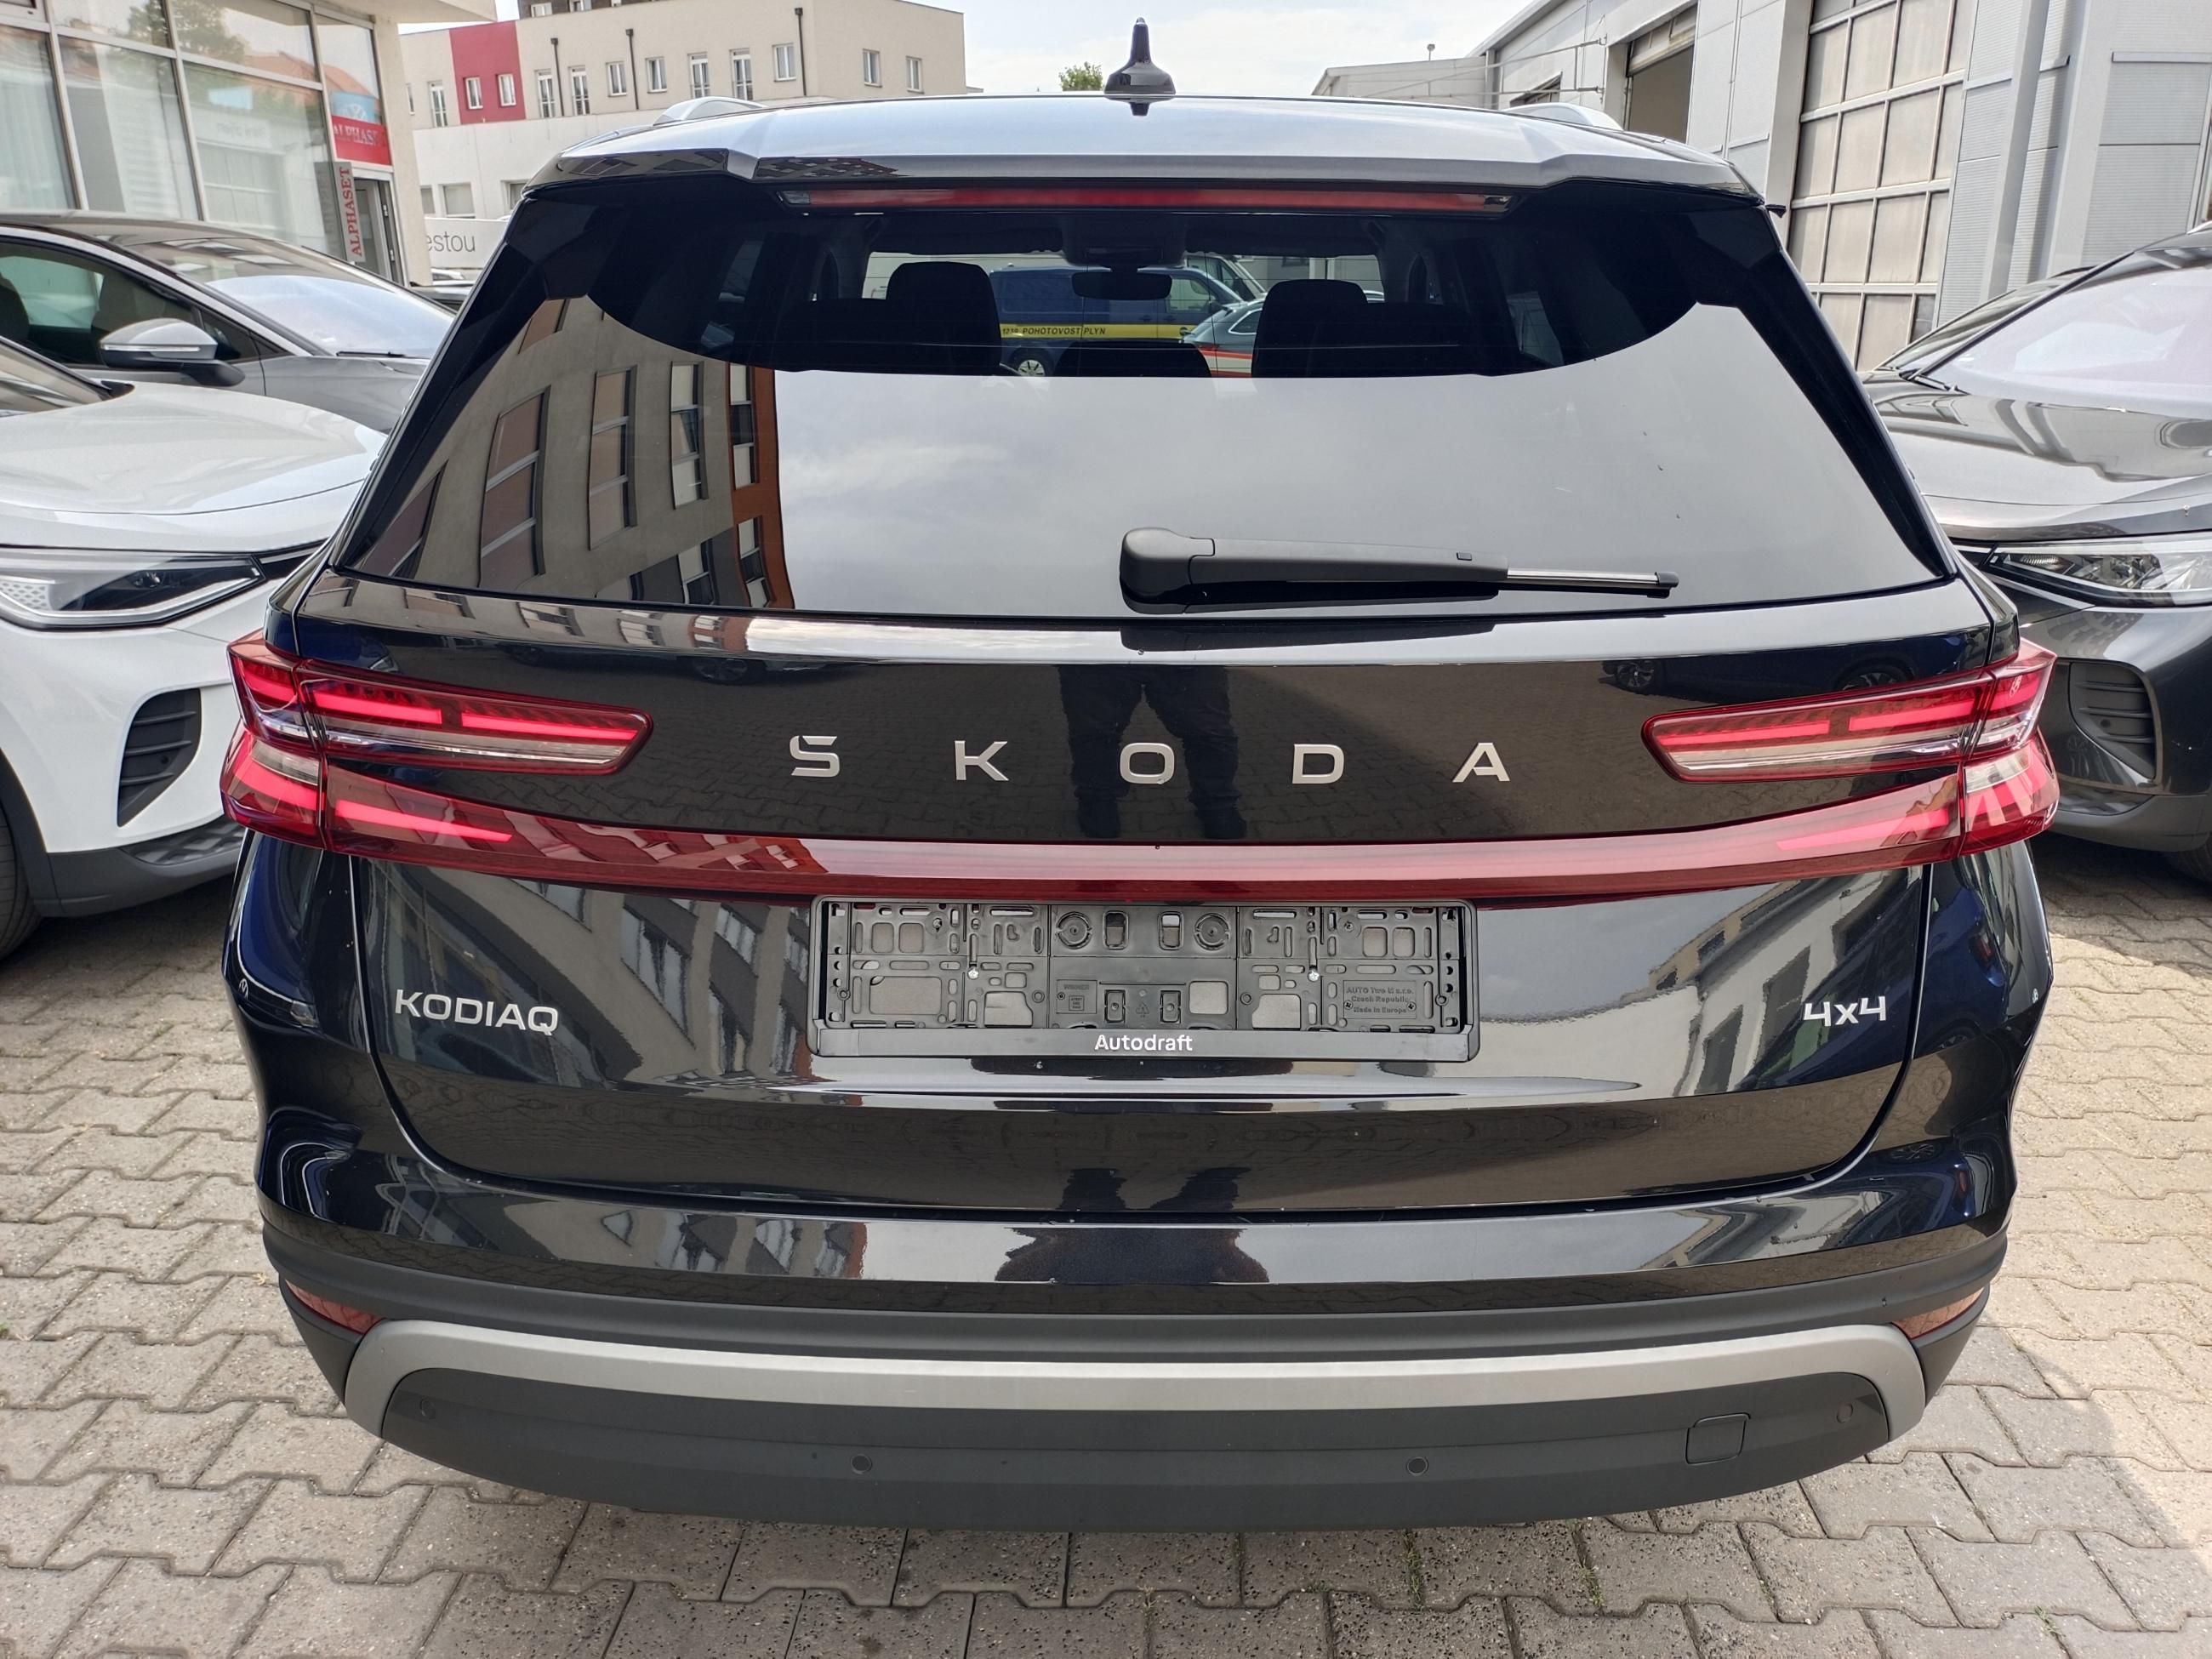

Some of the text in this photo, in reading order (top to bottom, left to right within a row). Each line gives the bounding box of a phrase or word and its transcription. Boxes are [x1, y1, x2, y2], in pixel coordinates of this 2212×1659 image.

[339, 167, 362, 257] ALPHASET
[395, 989, 559, 1036] KODIAQ
[1803, 995, 1886, 1027] 4x4
[1094, 1034, 1193, 1052] Autodraft
